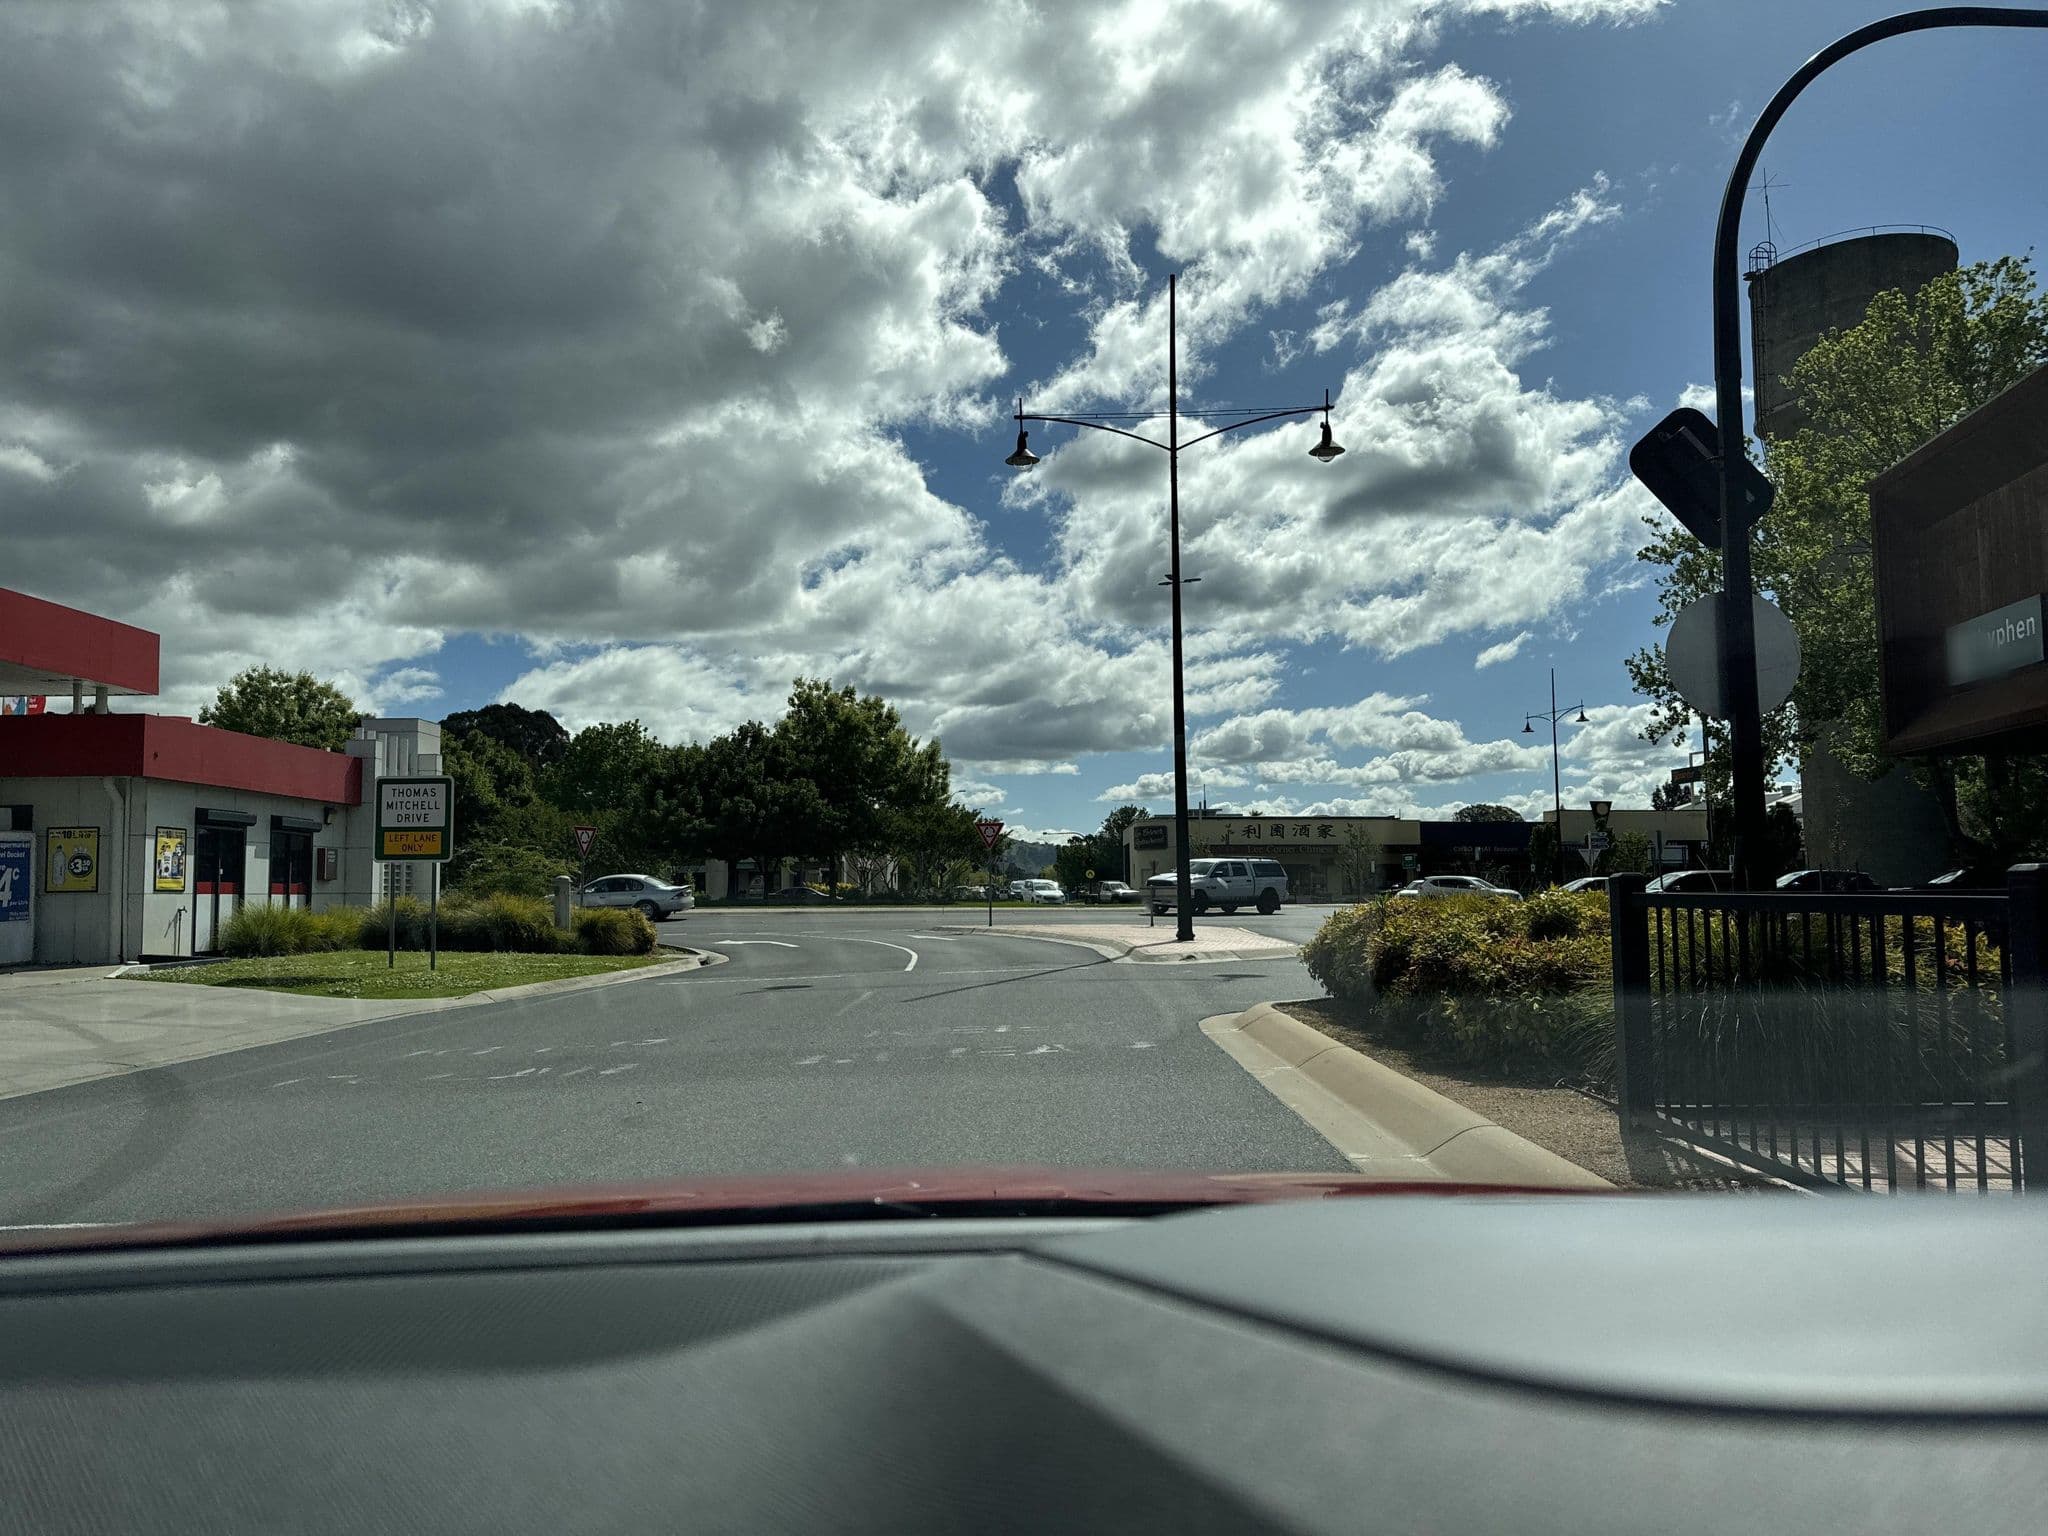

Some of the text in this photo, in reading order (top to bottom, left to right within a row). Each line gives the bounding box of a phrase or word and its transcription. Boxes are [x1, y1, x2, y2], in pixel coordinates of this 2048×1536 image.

[1985, 616, 2036, 650] yphen
[391, 787, 437, 798] THOMAS
[386, 800, 441, 811] MITCHELL
[396, 813, 430, 823] DRIVE
[388, 834, 438, 843] LEFT LANE
[401, 843, 424, 853] ONLY
